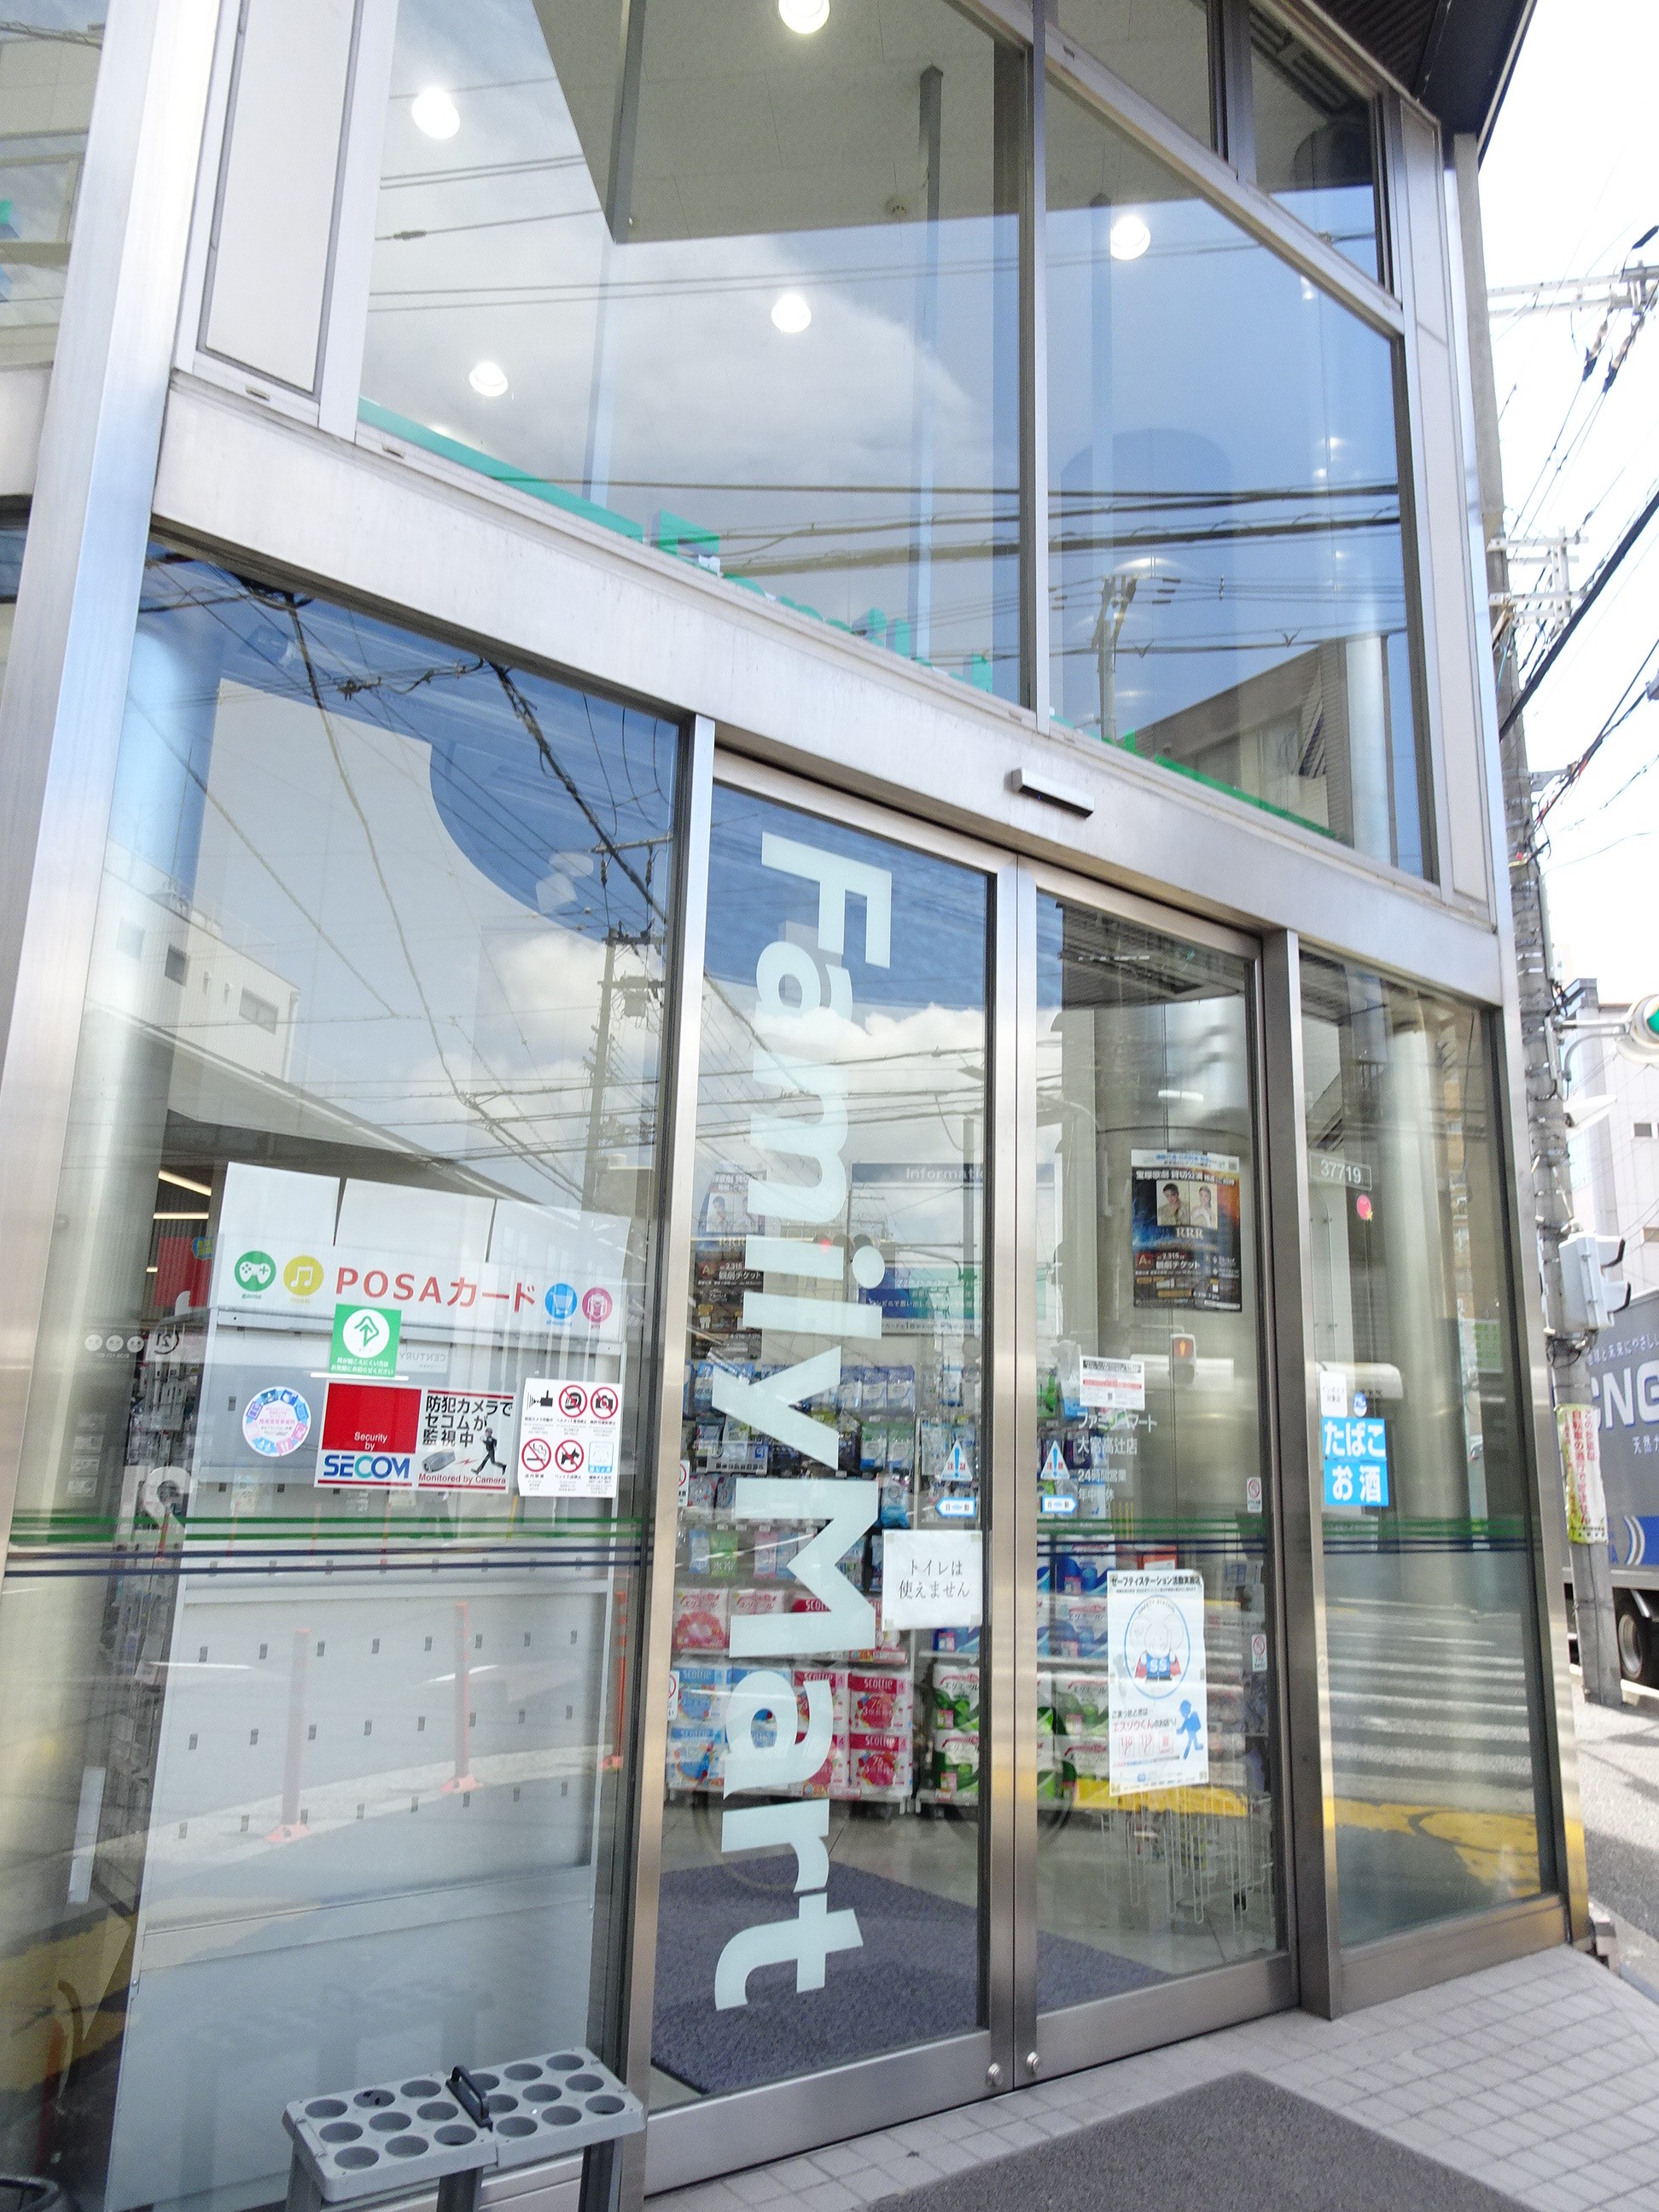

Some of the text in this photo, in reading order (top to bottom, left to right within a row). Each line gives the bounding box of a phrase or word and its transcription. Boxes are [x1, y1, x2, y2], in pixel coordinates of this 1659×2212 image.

[1319, 1158, 1362, 1185] 37719
[1176, 1227, 1203, 1238] RRR
[335, 1266, 536, 1313] POSAカード
[426, 1394, 512, 1417] 防犯カメラで
[1591, 1359, 1659, 1435] NG
[424, 1415, 488, 1432] セコムが
[712, 832, 894, 2011] FamilyMart
[354, 1431, 388, 1443] Security
[364, 1442, 375, 1452] by
[422, 1429, 474, 1448] 監視中
[1324, 1420, 1387, 1458] たばこ
[323, 1454, 410, 1480] SECOM
[418, 1472, 507, 1487] Monitored by Camera
[1332, 1464, 1382, 1504] お酒
[1078, 1487, 1115, 1503] 年中休
[910, 1558, 963, 1577] トイレは
[898, 1579, 970, 1600] 使えません
